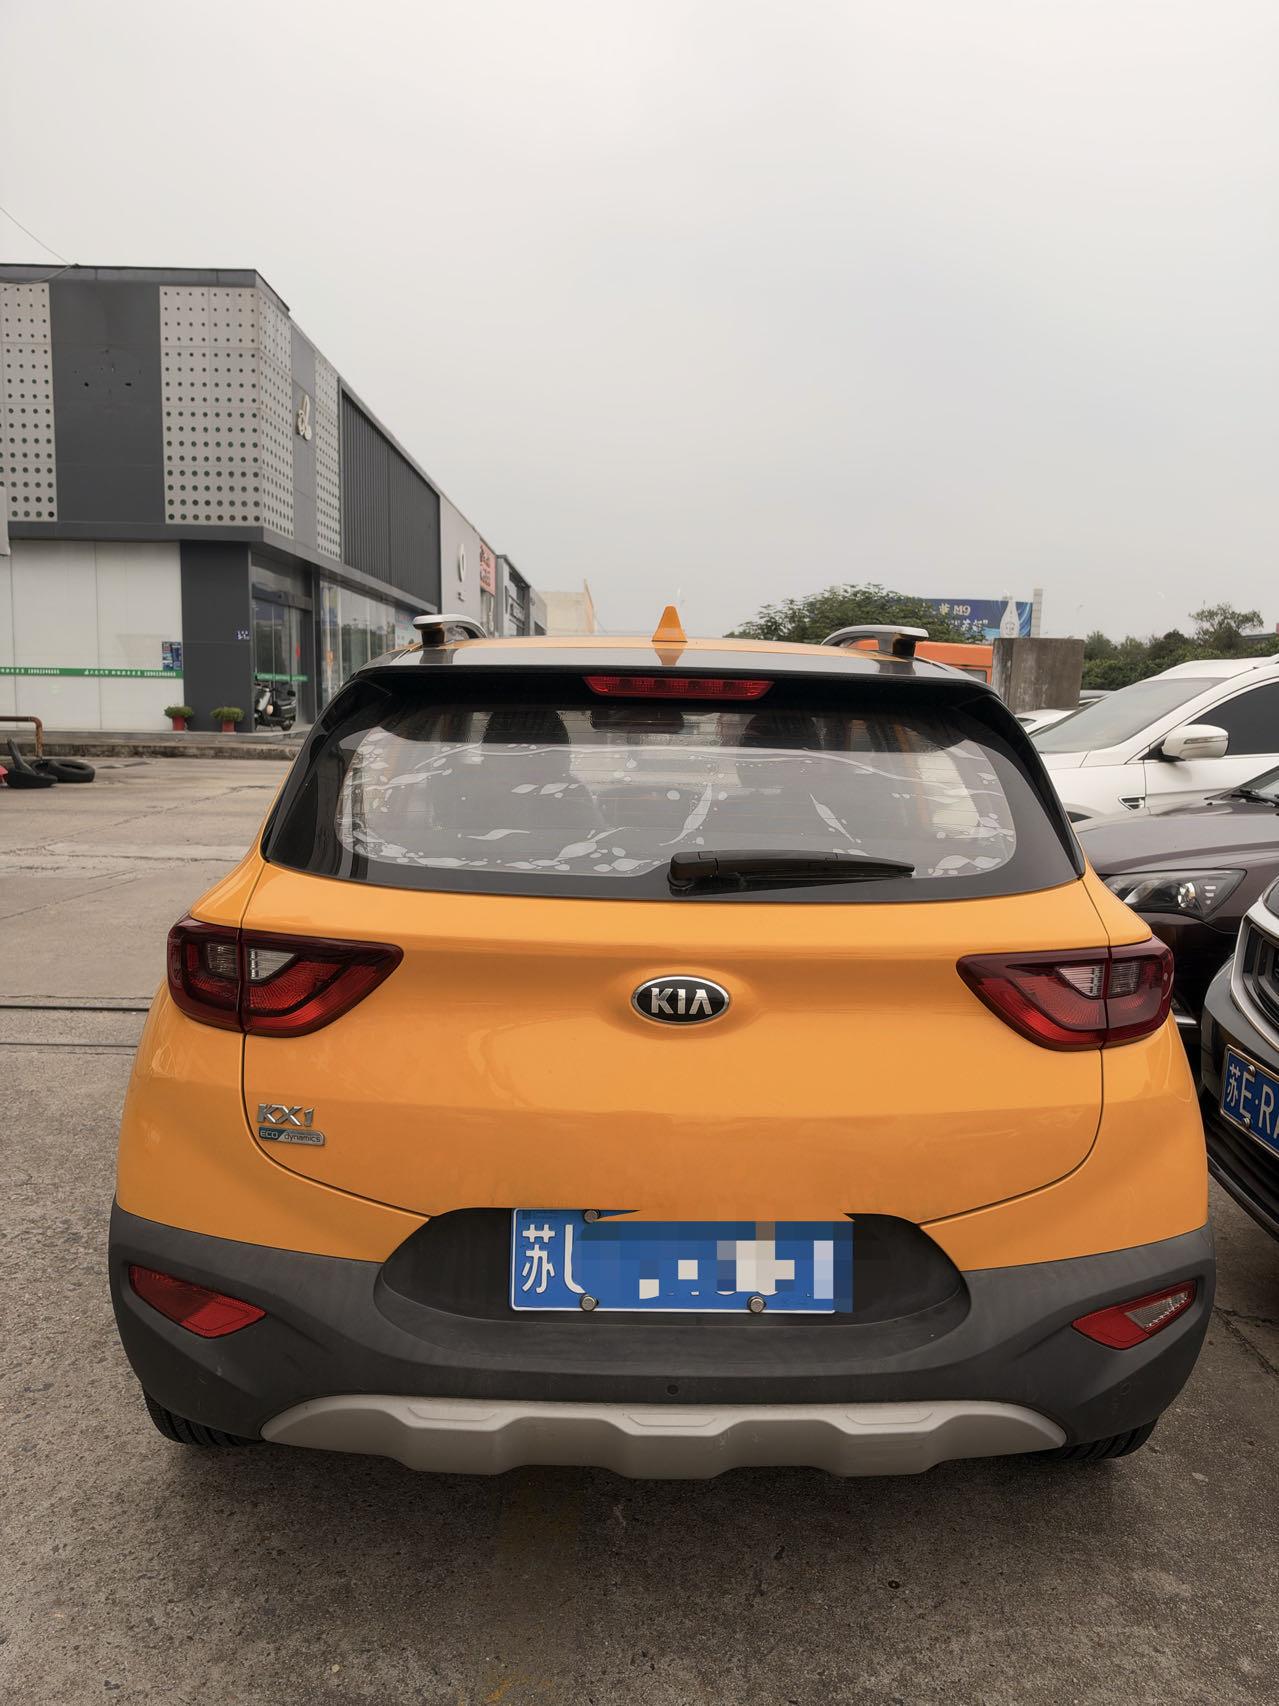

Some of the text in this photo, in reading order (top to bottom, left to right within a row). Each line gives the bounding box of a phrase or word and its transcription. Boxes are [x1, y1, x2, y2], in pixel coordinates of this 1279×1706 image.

[650, 987, 713, 1015] KIA
[257, 1103, 314, 1127] KX1
[284, 1131, 321, 1143] dynamics
